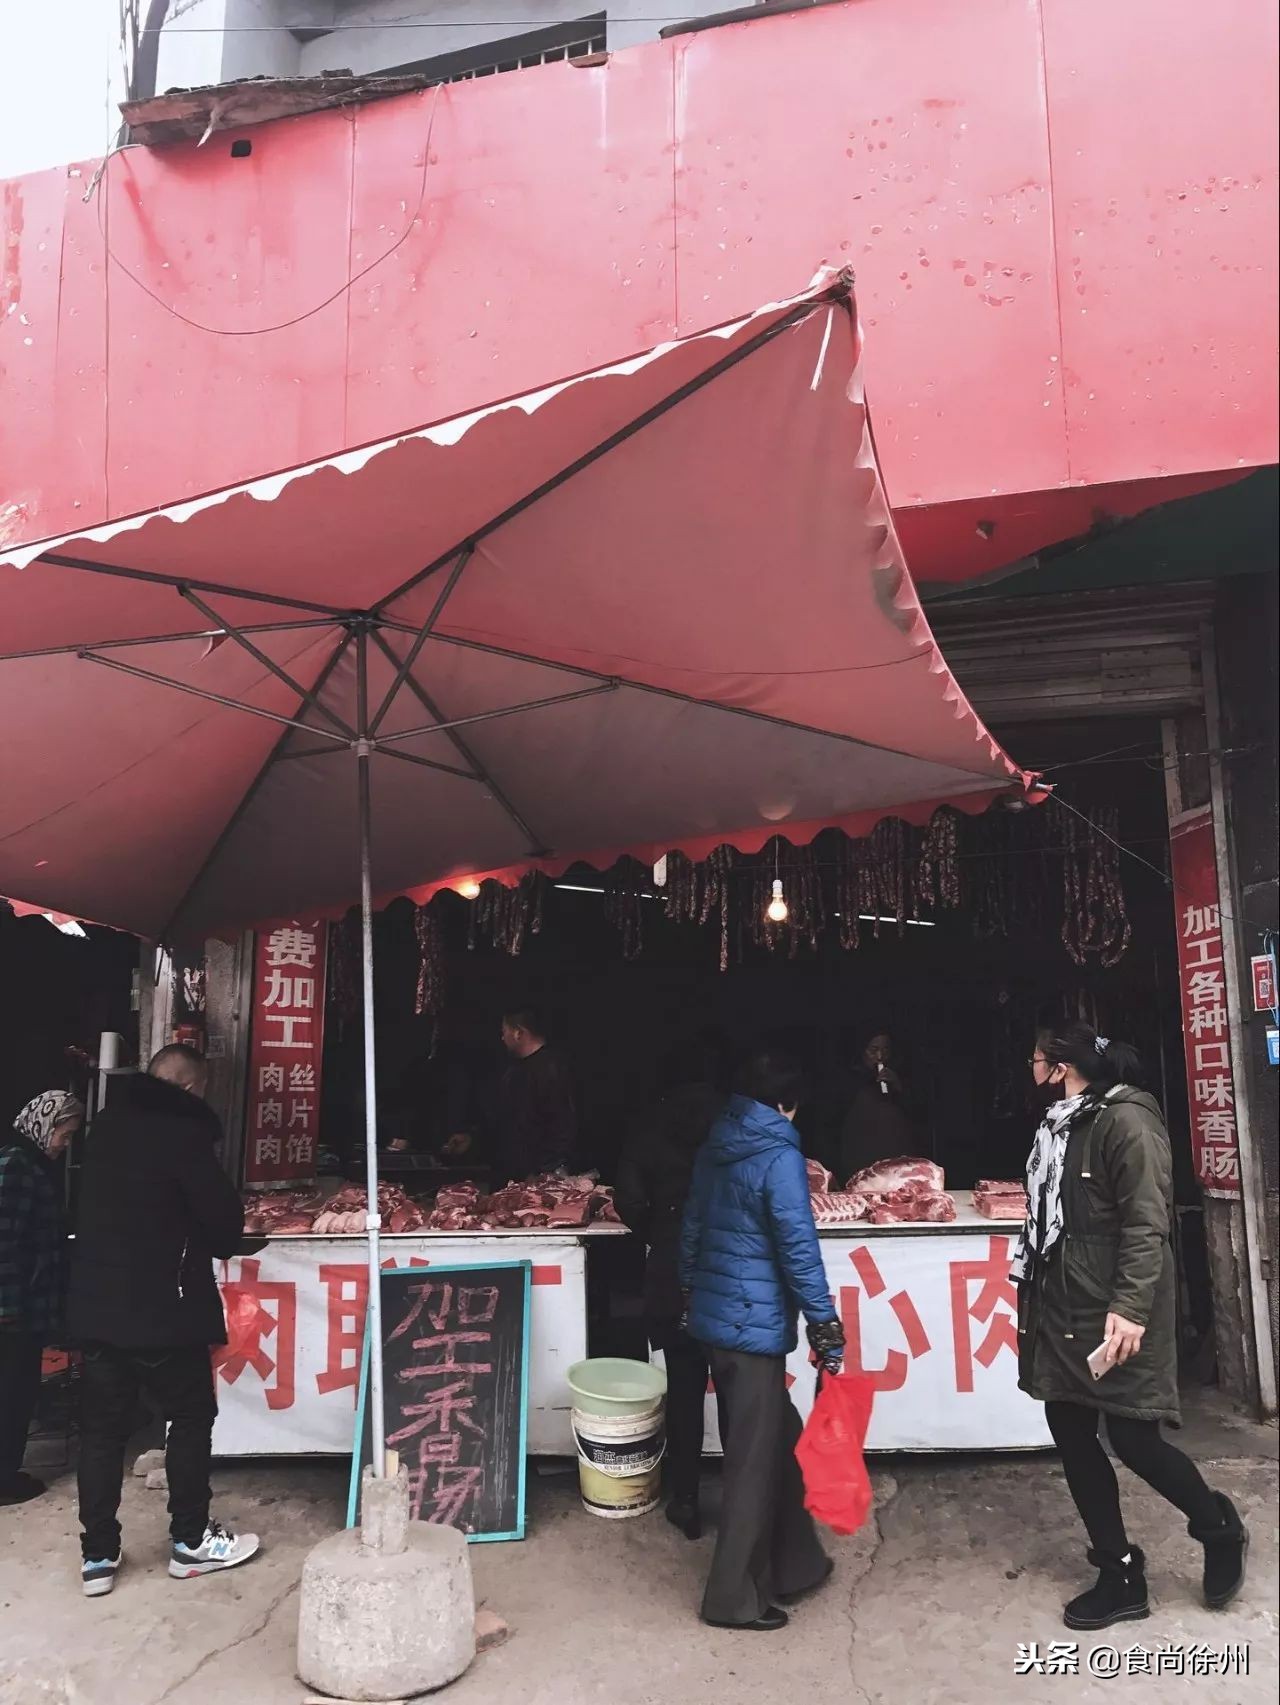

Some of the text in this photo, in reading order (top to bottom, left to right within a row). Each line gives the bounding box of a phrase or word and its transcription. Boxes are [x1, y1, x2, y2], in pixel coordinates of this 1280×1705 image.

[261, 920, 317, 1049] 费加工
[1182, 903, 1239, 1180] 加工各种口味香肠
[258, 1062, 315, 1093] 肉丝
[256, 1098, 314, 1130] 肉片
[255, 1134, 313, 1165] 肉馅
